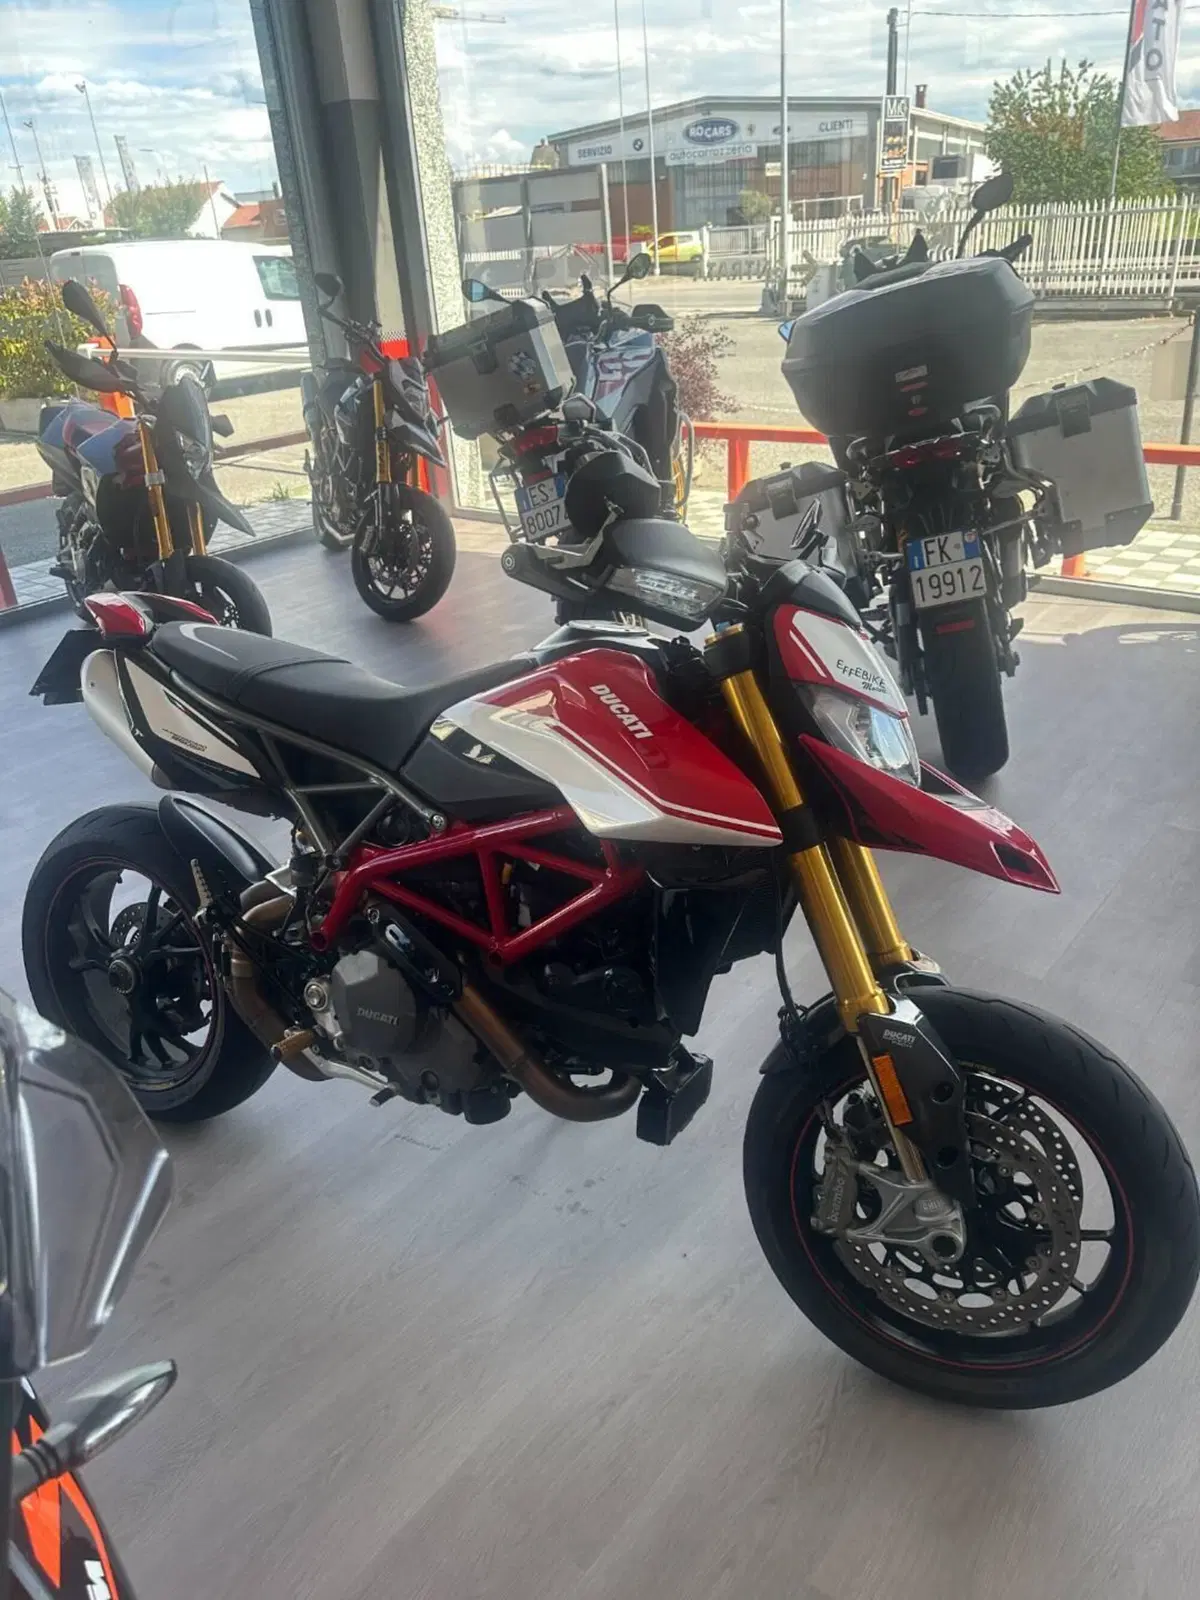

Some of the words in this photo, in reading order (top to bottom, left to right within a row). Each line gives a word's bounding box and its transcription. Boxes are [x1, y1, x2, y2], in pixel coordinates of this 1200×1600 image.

[819, 118, 854, 133] CLIENTI
[577, 145, 613, 159] SERVIZIO
[528, 483, 550, 508] ES
[526, 504, 569, 535] 8007
[924, 536, 953, 566] FK
[915, 564, 984, 603] 19912
[836, 659, 887, 690] EFFEBIKE
[588, 683, 655, 740] DUCATI
[356, 1007, 399, 1026] DUCATI
[884, 1028, 917, 1045] DUCATI
